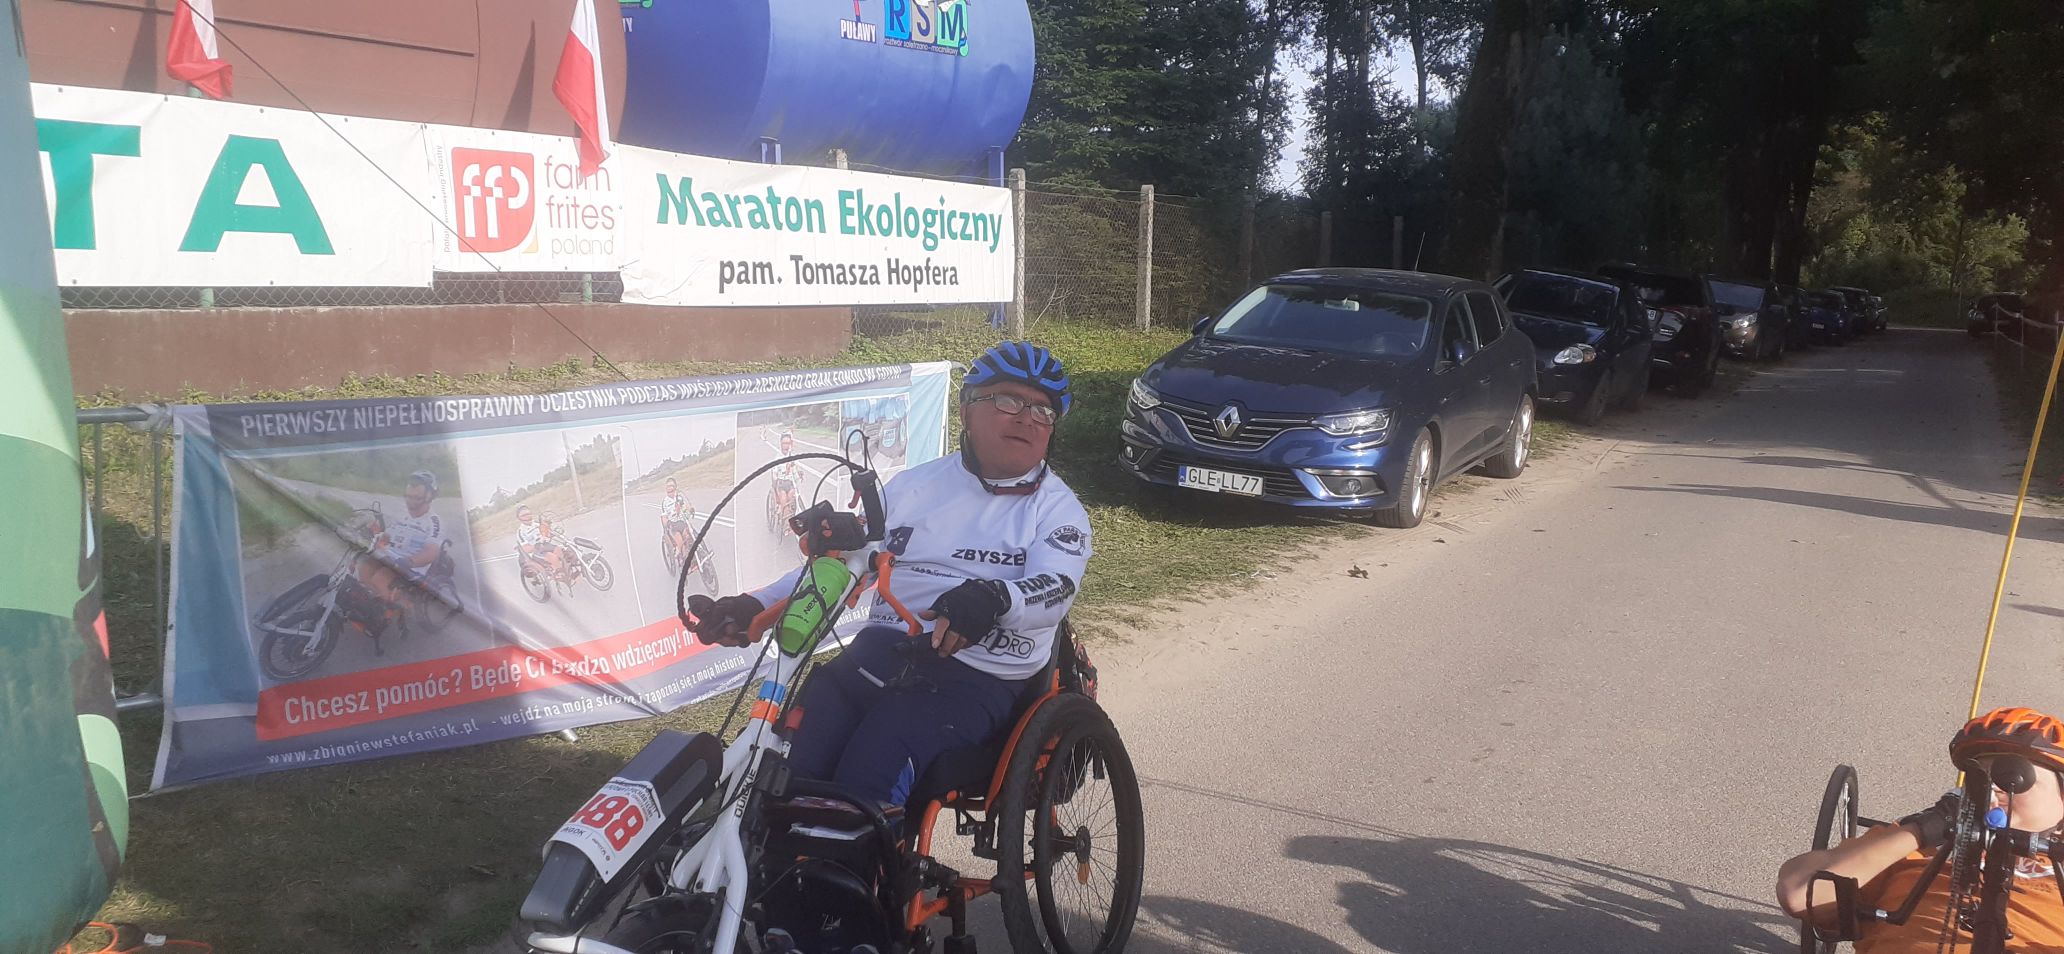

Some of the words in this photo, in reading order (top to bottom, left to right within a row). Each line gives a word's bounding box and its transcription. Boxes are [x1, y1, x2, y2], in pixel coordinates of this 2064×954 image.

[840, 19, 876, 42] PUŁAWY
[546, 195, 615, 230] frites
[656, 173, 827, 234] Maraton
[838, 187, 1002, 254] Ekologiczny
[551, 235, 615, 259] poland
[718, 257, 783, 293] pam.
[789, 254, 881, 287] Tomasza
[887, 257, 959, 293] Hopfera
[241, 408, 346, 438] PIERWSZY
[353, 395, 534, 430] NIEPEŁNOSPRAWNY
[540, 387, 618, 413] UCZESTNIK
[617, 384, 678, 405] PODCZAS
[677, 379, 731, 400] WYŚCIGU
[733, 374, 803, 395] KOLARSKIEGO
[804, 371, 832, 389] GRAN
[833, 368, 866, 386] FONDO
[865, 367, 876, 382] W
[876, 365, 902, 381] GDYNI
[1189, 468, 1217, 486] GLE
[1222, 473, 1260, 492] LL77
[952, 548, 1026, 567] ZBYSZE
[983, 628, 1032, 655] YDRO
[285, 690, 370, 725] Chcesz
[376, 669, 463, 714] pomóc?
[470, 660, 522, 693] Będę
[525, 655, 546, 679] Ci
[612, 627, 682, 672] wdzięczny!
[266, 718, 480, 764] www.zbigniewstefaniak.pl
[500, 705, 542, 726] wejdź
[543, 704, 561, 717] na
[562, 696, 594, 713] moją
[645, 678, 682, 703] zapoznaj
[680, 675, 693, 688] się
[692, 674, 697, 684] z
[697, 665, 716, 680] moją
[714, 653, 746, 674] historią
